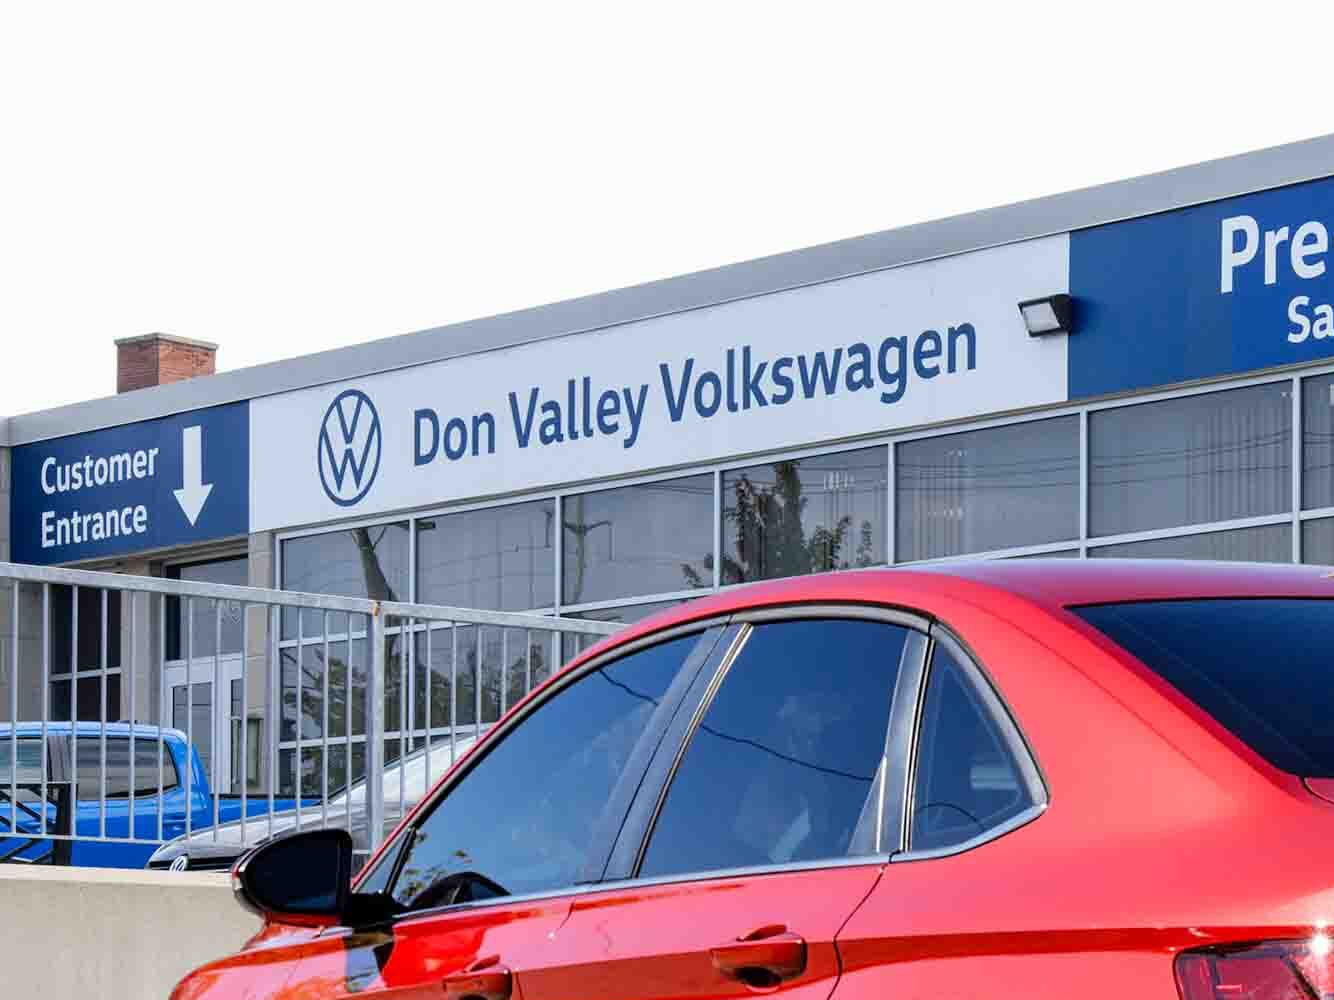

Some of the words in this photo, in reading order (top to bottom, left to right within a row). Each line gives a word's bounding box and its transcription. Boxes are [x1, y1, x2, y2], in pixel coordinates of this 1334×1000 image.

[413, 408, 495, 466] Don
[509, 377, 648, 449] Valley
[660, 321, 977, 422] Volkswagen
[40, 447, 159, 495] Customer
[318, 390, 381, 506] VW
[41, 504, 147, 548] Entrance
